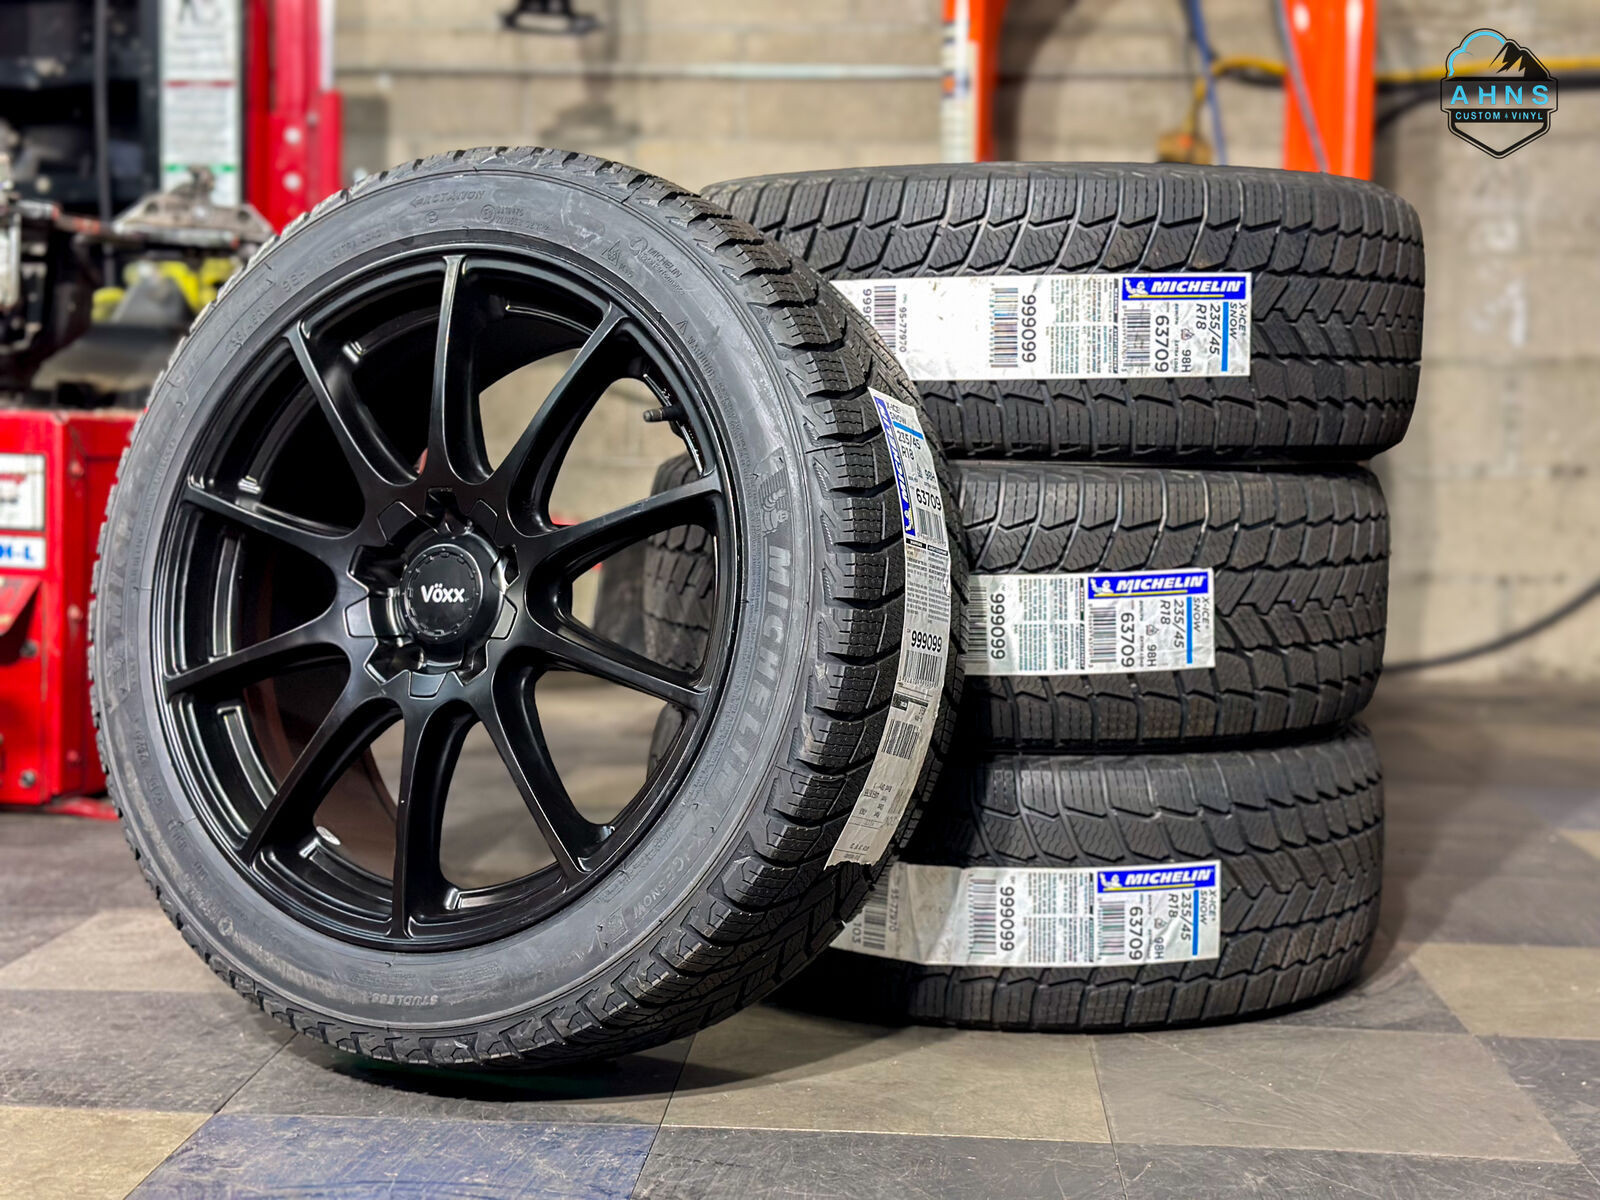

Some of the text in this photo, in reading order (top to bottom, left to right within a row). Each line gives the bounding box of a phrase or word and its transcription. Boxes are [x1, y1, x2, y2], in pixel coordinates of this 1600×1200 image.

[1150, 280, 1241, 293] MICHELIN
[899, 307, 907, 353] 95-77970
[1021, 294, 1036, 363] 999099
[1195, 303, 1207, 330] R18
[1208, 303, 1222, 356] 235/45
[1229, 302, 1238, 340] SNOW
[1154, 315, 1169, 372] 63709
[1181, 349, 1191, 373] 98H
[876, 401, 909, 504] MICHELIN
[897, 430, 921, 450] 235/45
[901, 445, 914, 461] R18
[915, 487, 942, 511] 63709
[1115, 575, 1204, 592] MICHELIN
[990, 593, 1006, 660] 999099
[1160, 599, 1171, 625] R18
[1172, 599, 1186, 649] 235/45
[1193, 597, 1201, 633] SNOW
[911, 630, 942, 653] 999099
[1120, 612, 1135, 668] 63709
[1147, 644, 1157, 667] 98H
[1124, 868, 1212, 886] MICHELIN
[1000, 886, 1014, 951] 999099
[1168, 893, 1178, 918] R18
[1180, 892, 1194, 941] 235/45
[1199, 890, 1208, 925] SNOW
[1129, 906, 1143, 960] 63709
[1154, 936, 1165, 960] 98H
